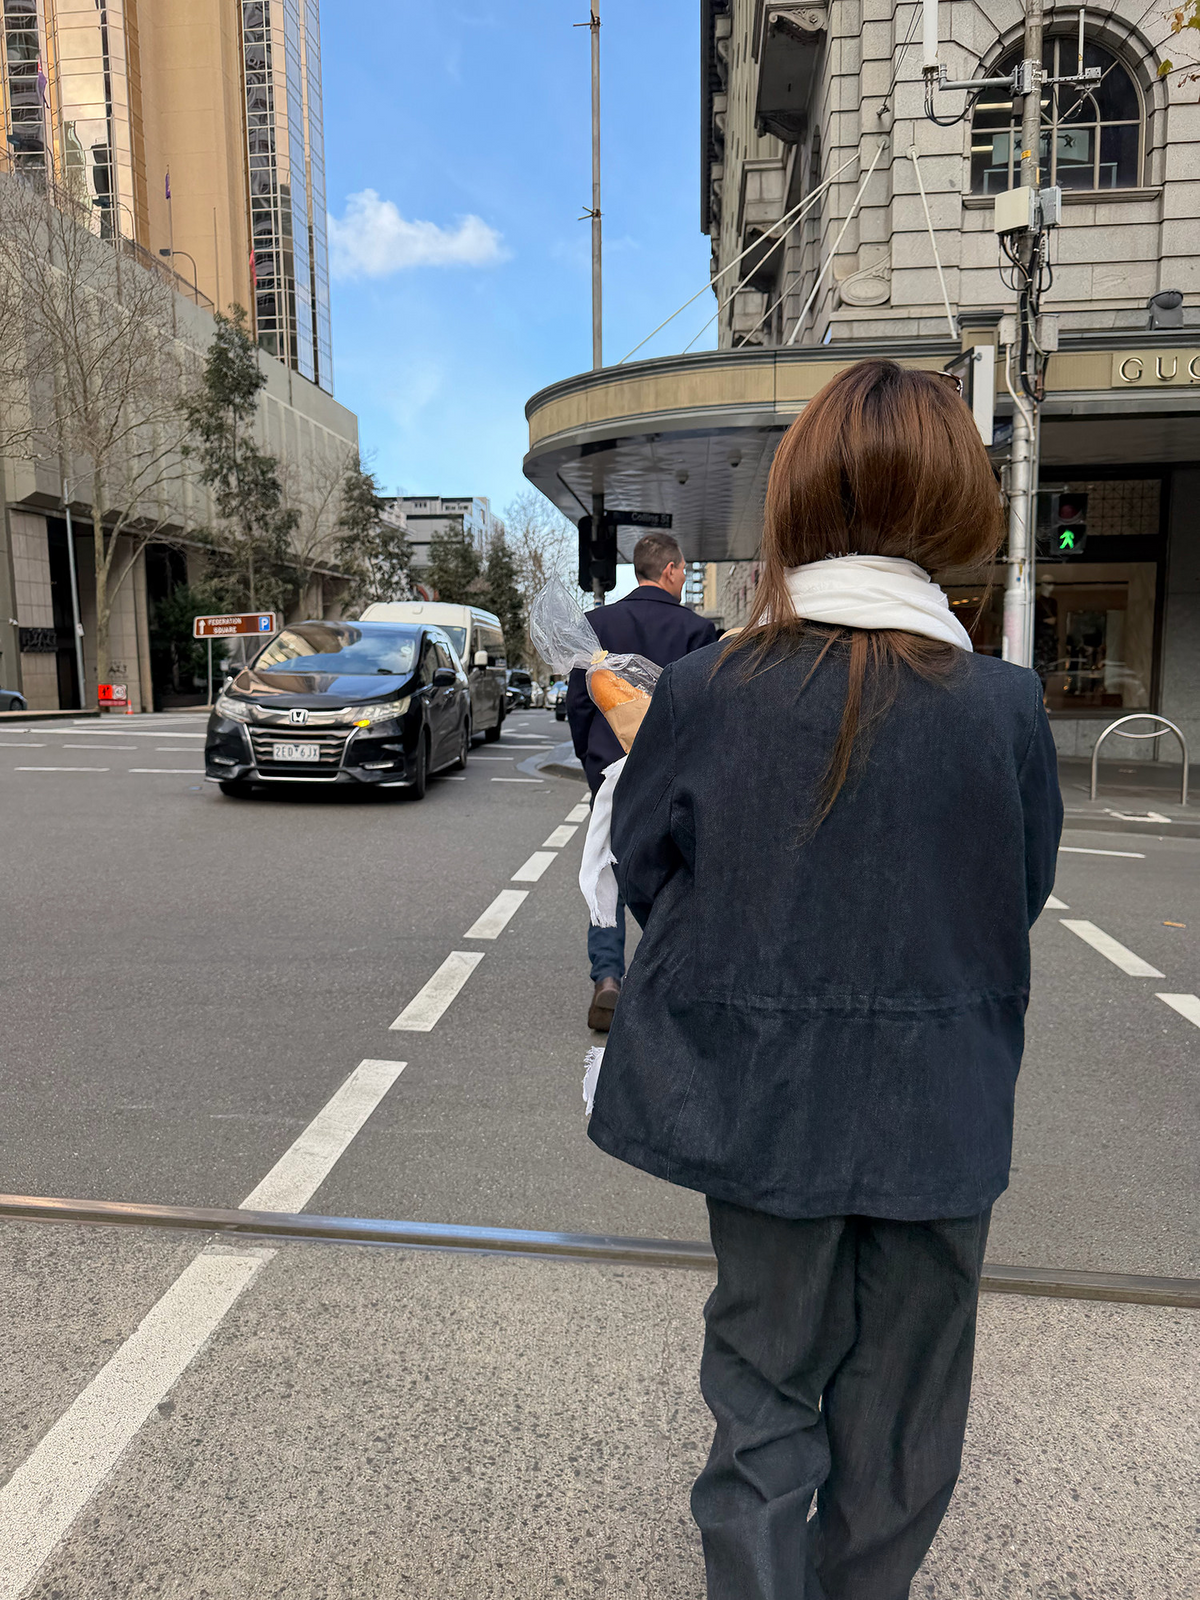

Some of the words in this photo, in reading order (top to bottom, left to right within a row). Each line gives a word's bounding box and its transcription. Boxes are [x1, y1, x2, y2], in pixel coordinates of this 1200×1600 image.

[208, 617, 242, 626] FEDERATION
[261, 618, 269, 630] P
[213, 626, 237, 634] SQUARE
